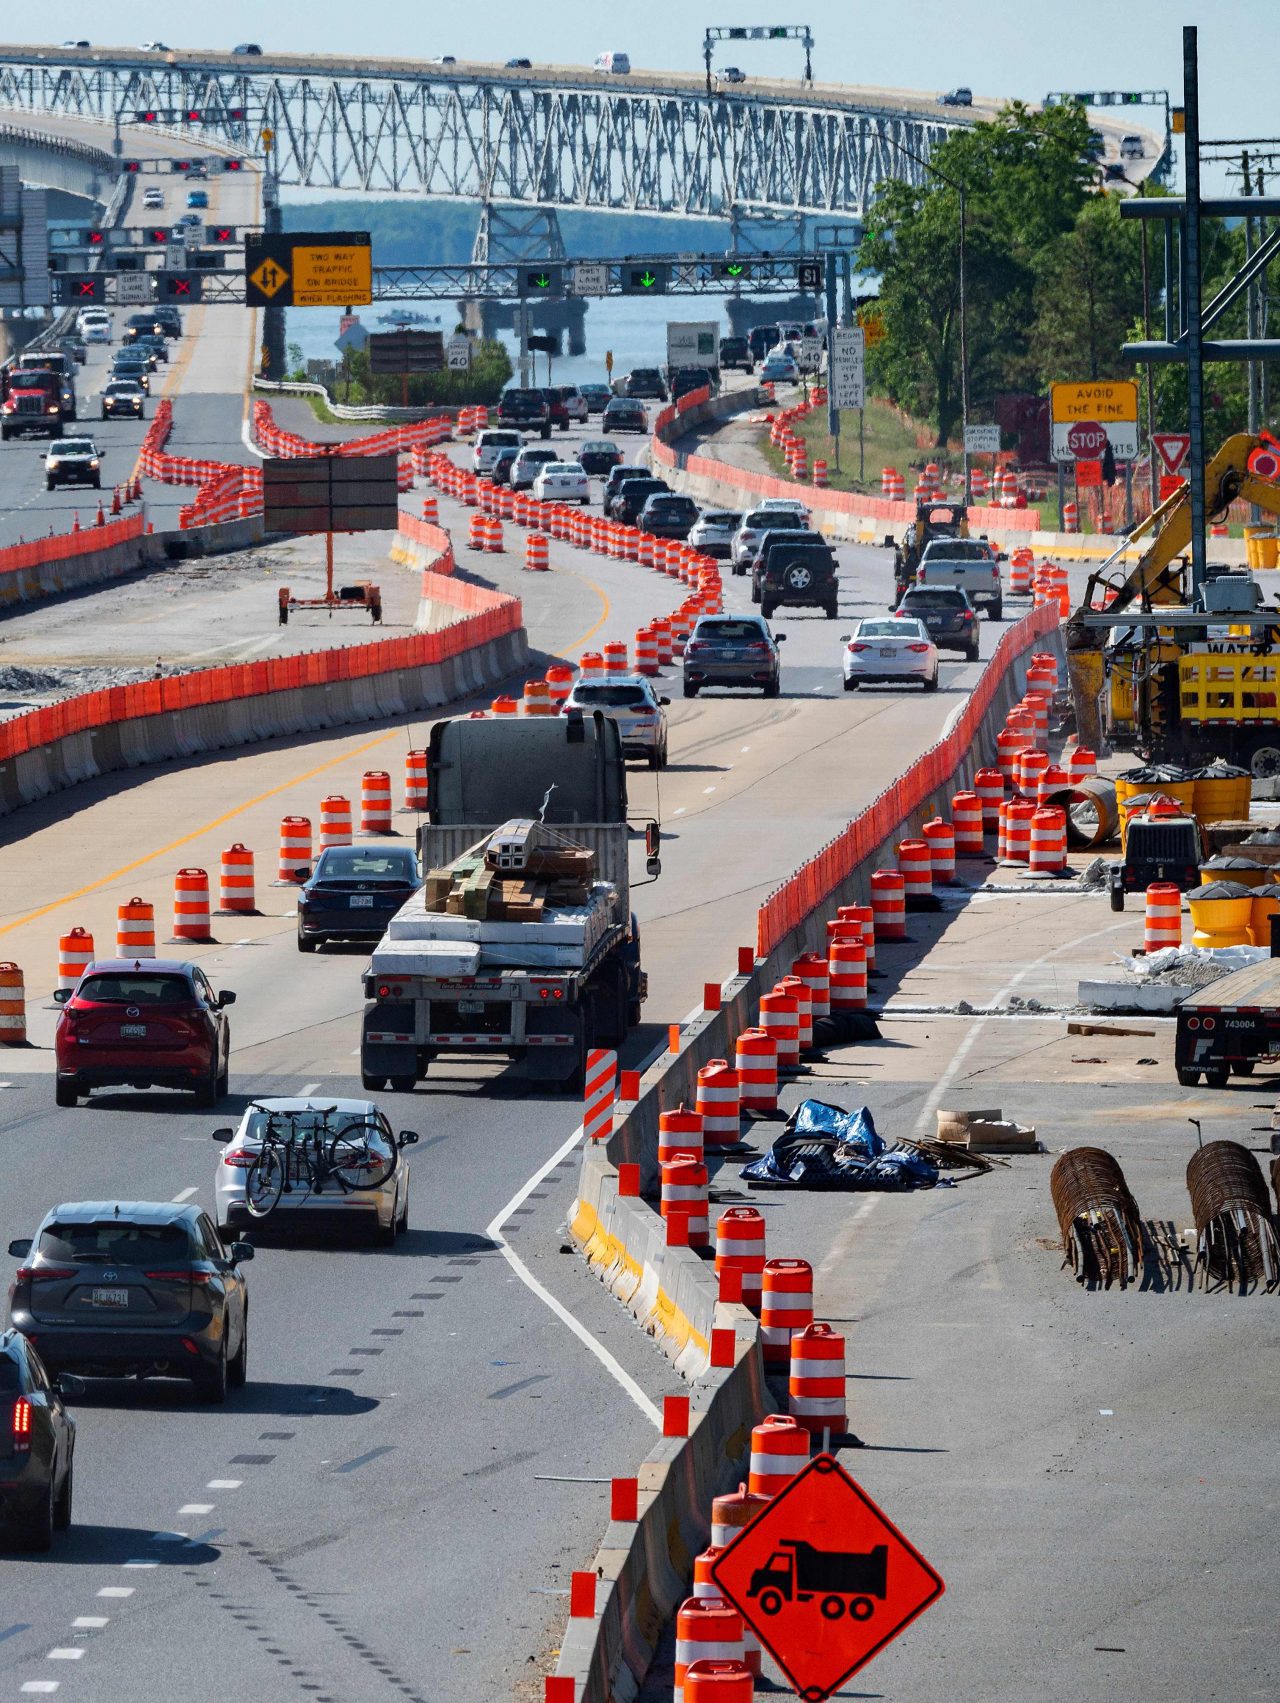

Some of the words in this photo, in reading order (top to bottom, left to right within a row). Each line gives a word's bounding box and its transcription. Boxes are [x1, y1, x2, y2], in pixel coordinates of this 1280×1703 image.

[310, 253, 329, 261] TWO
[313, 265, 352, 273] TRAFFIC
[306, 278, 320, 286] ON
[324, 278, 359, 286] BRIDGE
[300, 295, 322, 303] WHEN
[327, 293, 367, 302] FLASHING
[841, 346, 856, 356] NO
[450, 357, 467, 367] 40
[804, 352, 820, 362] 40
[839, 390, 859, 399] LEFT
[1077, 388, 1113, 399] AVOID
[1067, 404, 1089, 415] THE
[1096, 404, 1124, 415] FINE
[1070, 432, 1105, 448] STOP
[1224, 1020, 1256, 1029] 743004
